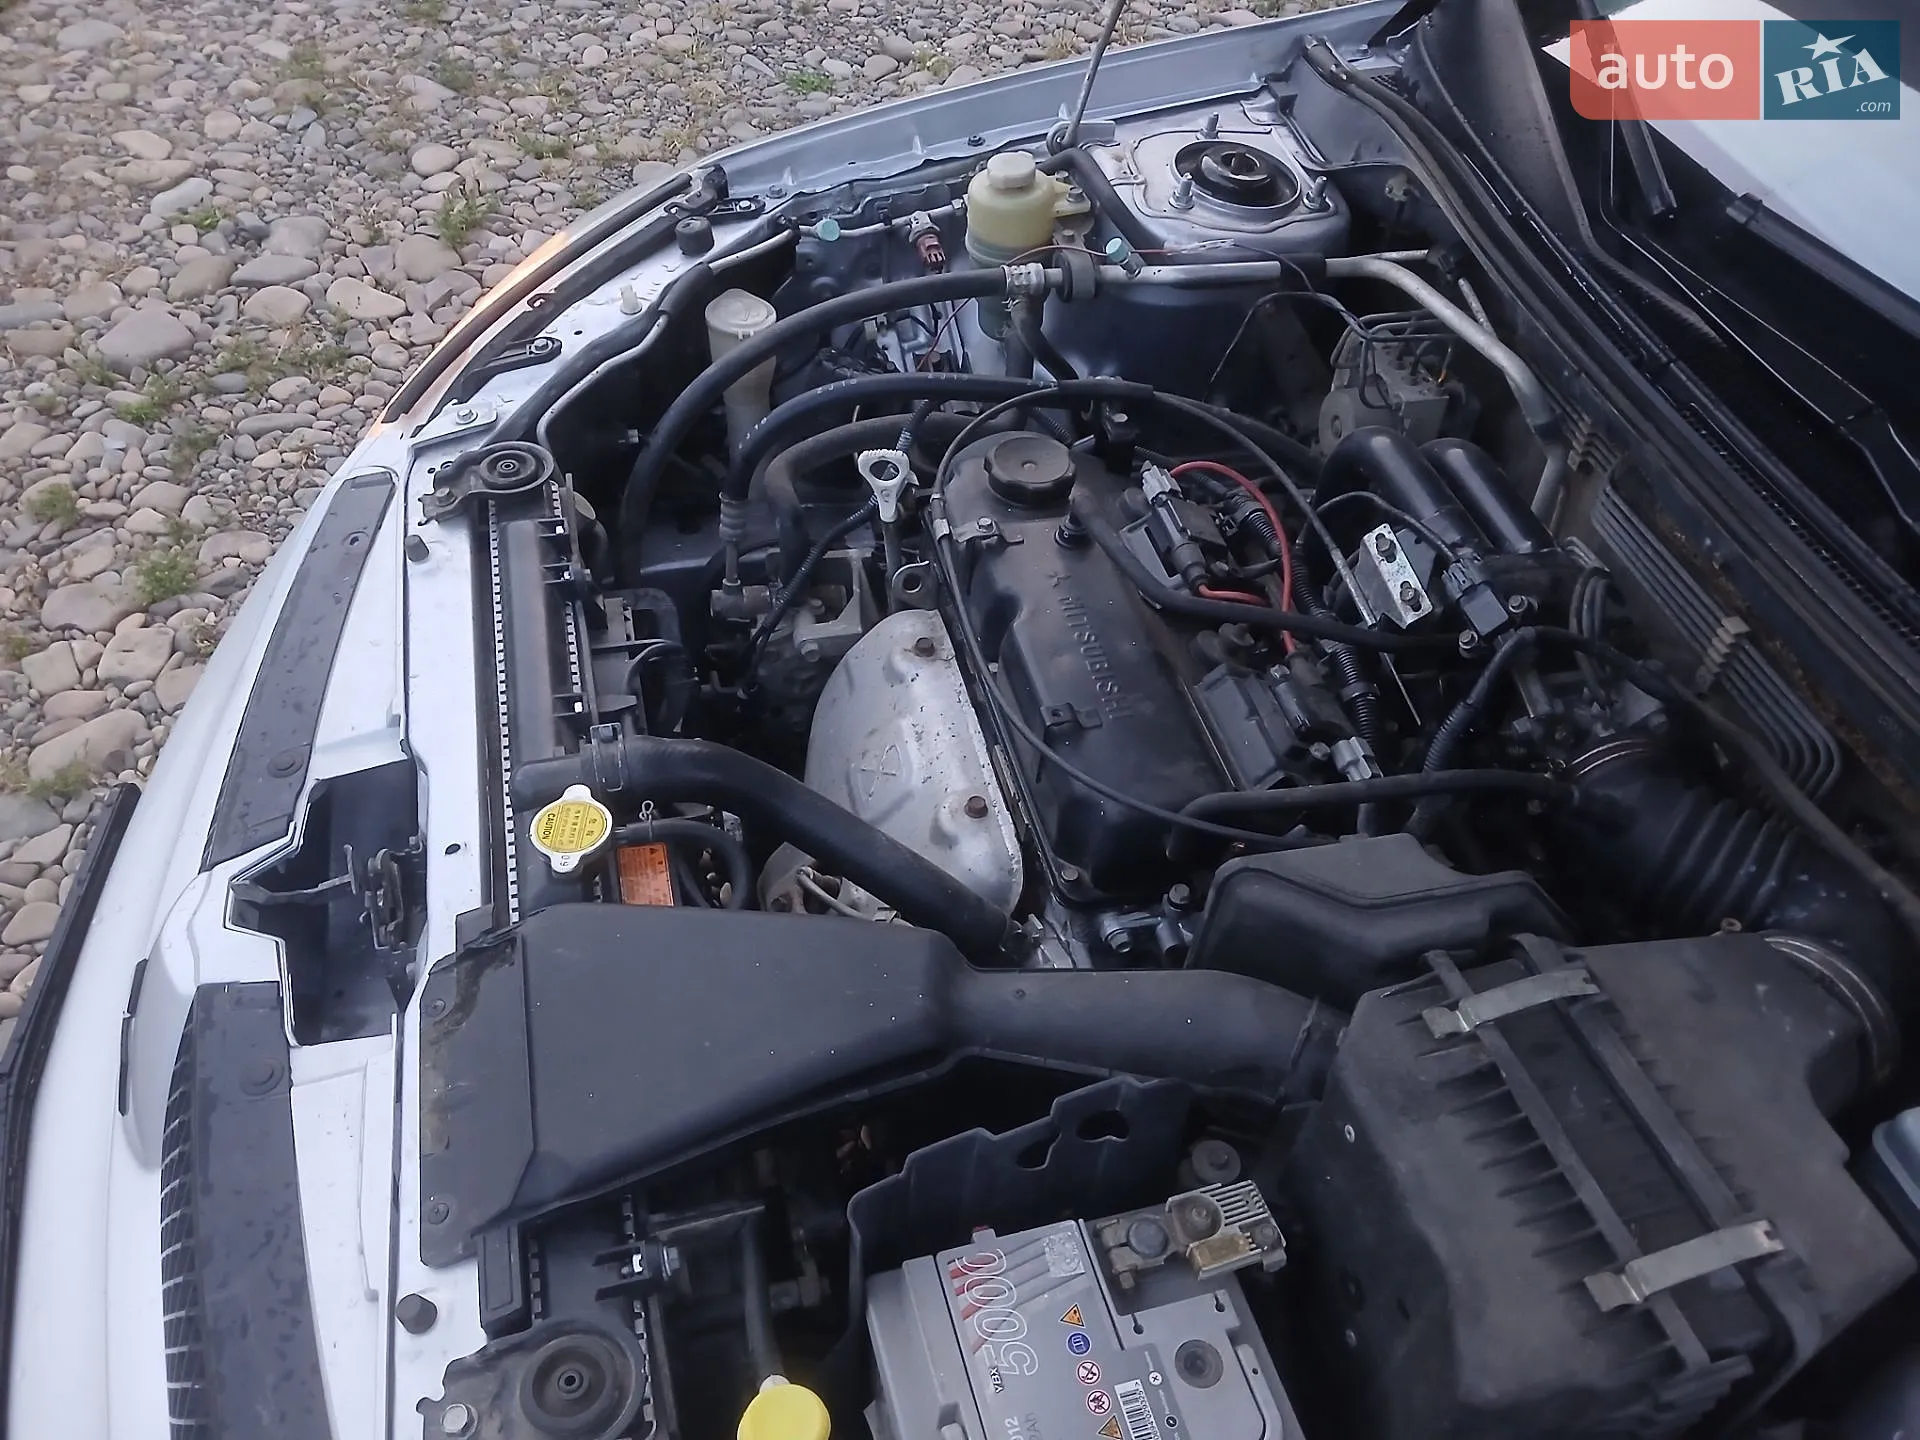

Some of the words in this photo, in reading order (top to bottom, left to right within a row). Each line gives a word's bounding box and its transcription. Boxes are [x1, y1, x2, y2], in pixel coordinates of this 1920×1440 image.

[1058, 595, 1135, 720] MITSUBISHI
[542, 812, 556, 840] CAUTION
[954, 1248, 1038, 1376] 5000
[990, 1367, 1005, 1393] YBX
